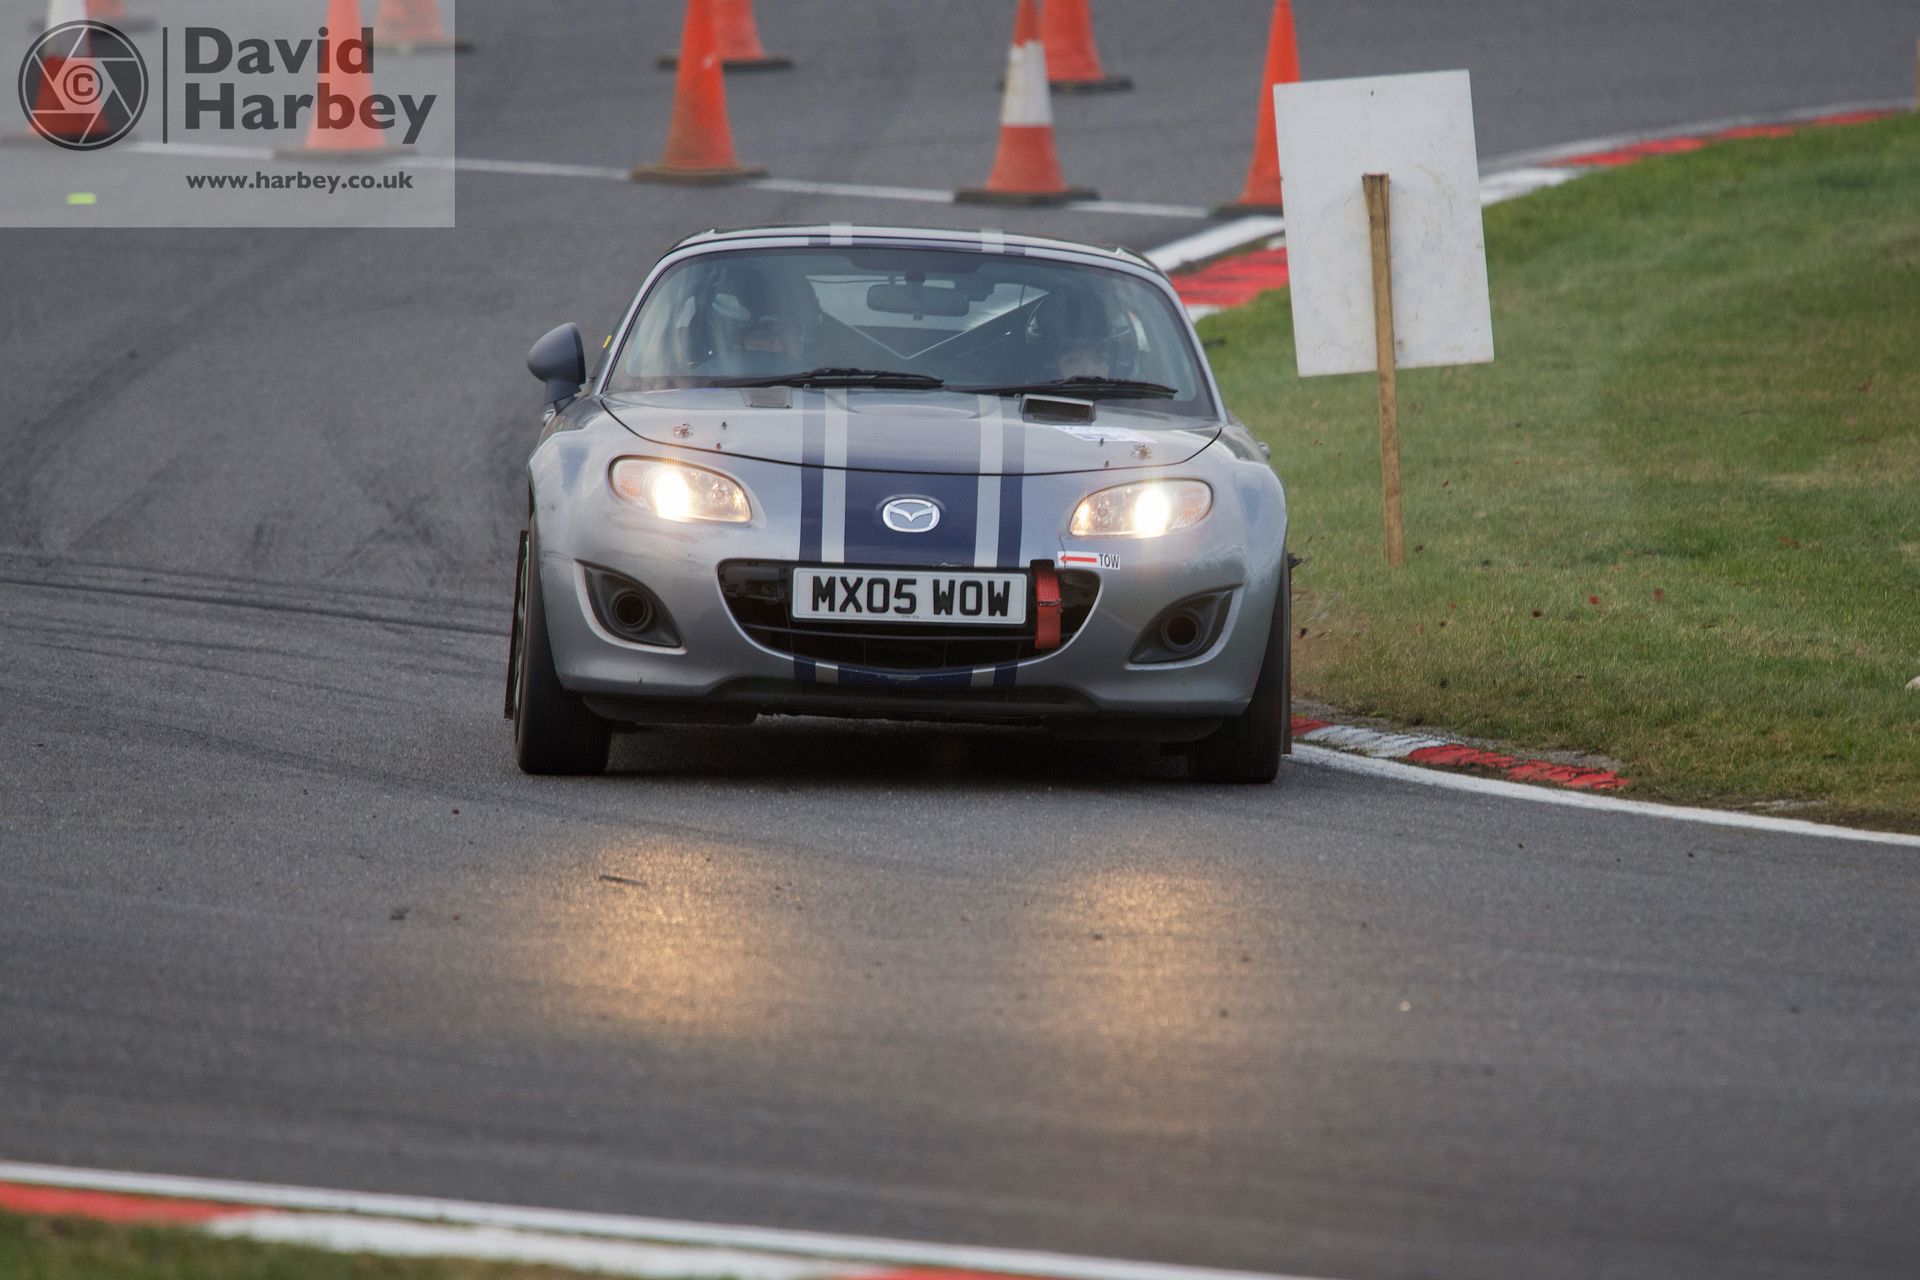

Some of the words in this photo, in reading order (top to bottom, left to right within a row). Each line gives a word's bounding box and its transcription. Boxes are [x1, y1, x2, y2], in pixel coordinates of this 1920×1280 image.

[1099, 553, 1120, 569] TOW
[811, 575, 917, 615] MX05
[932, 579, 1011, 617] WOW
